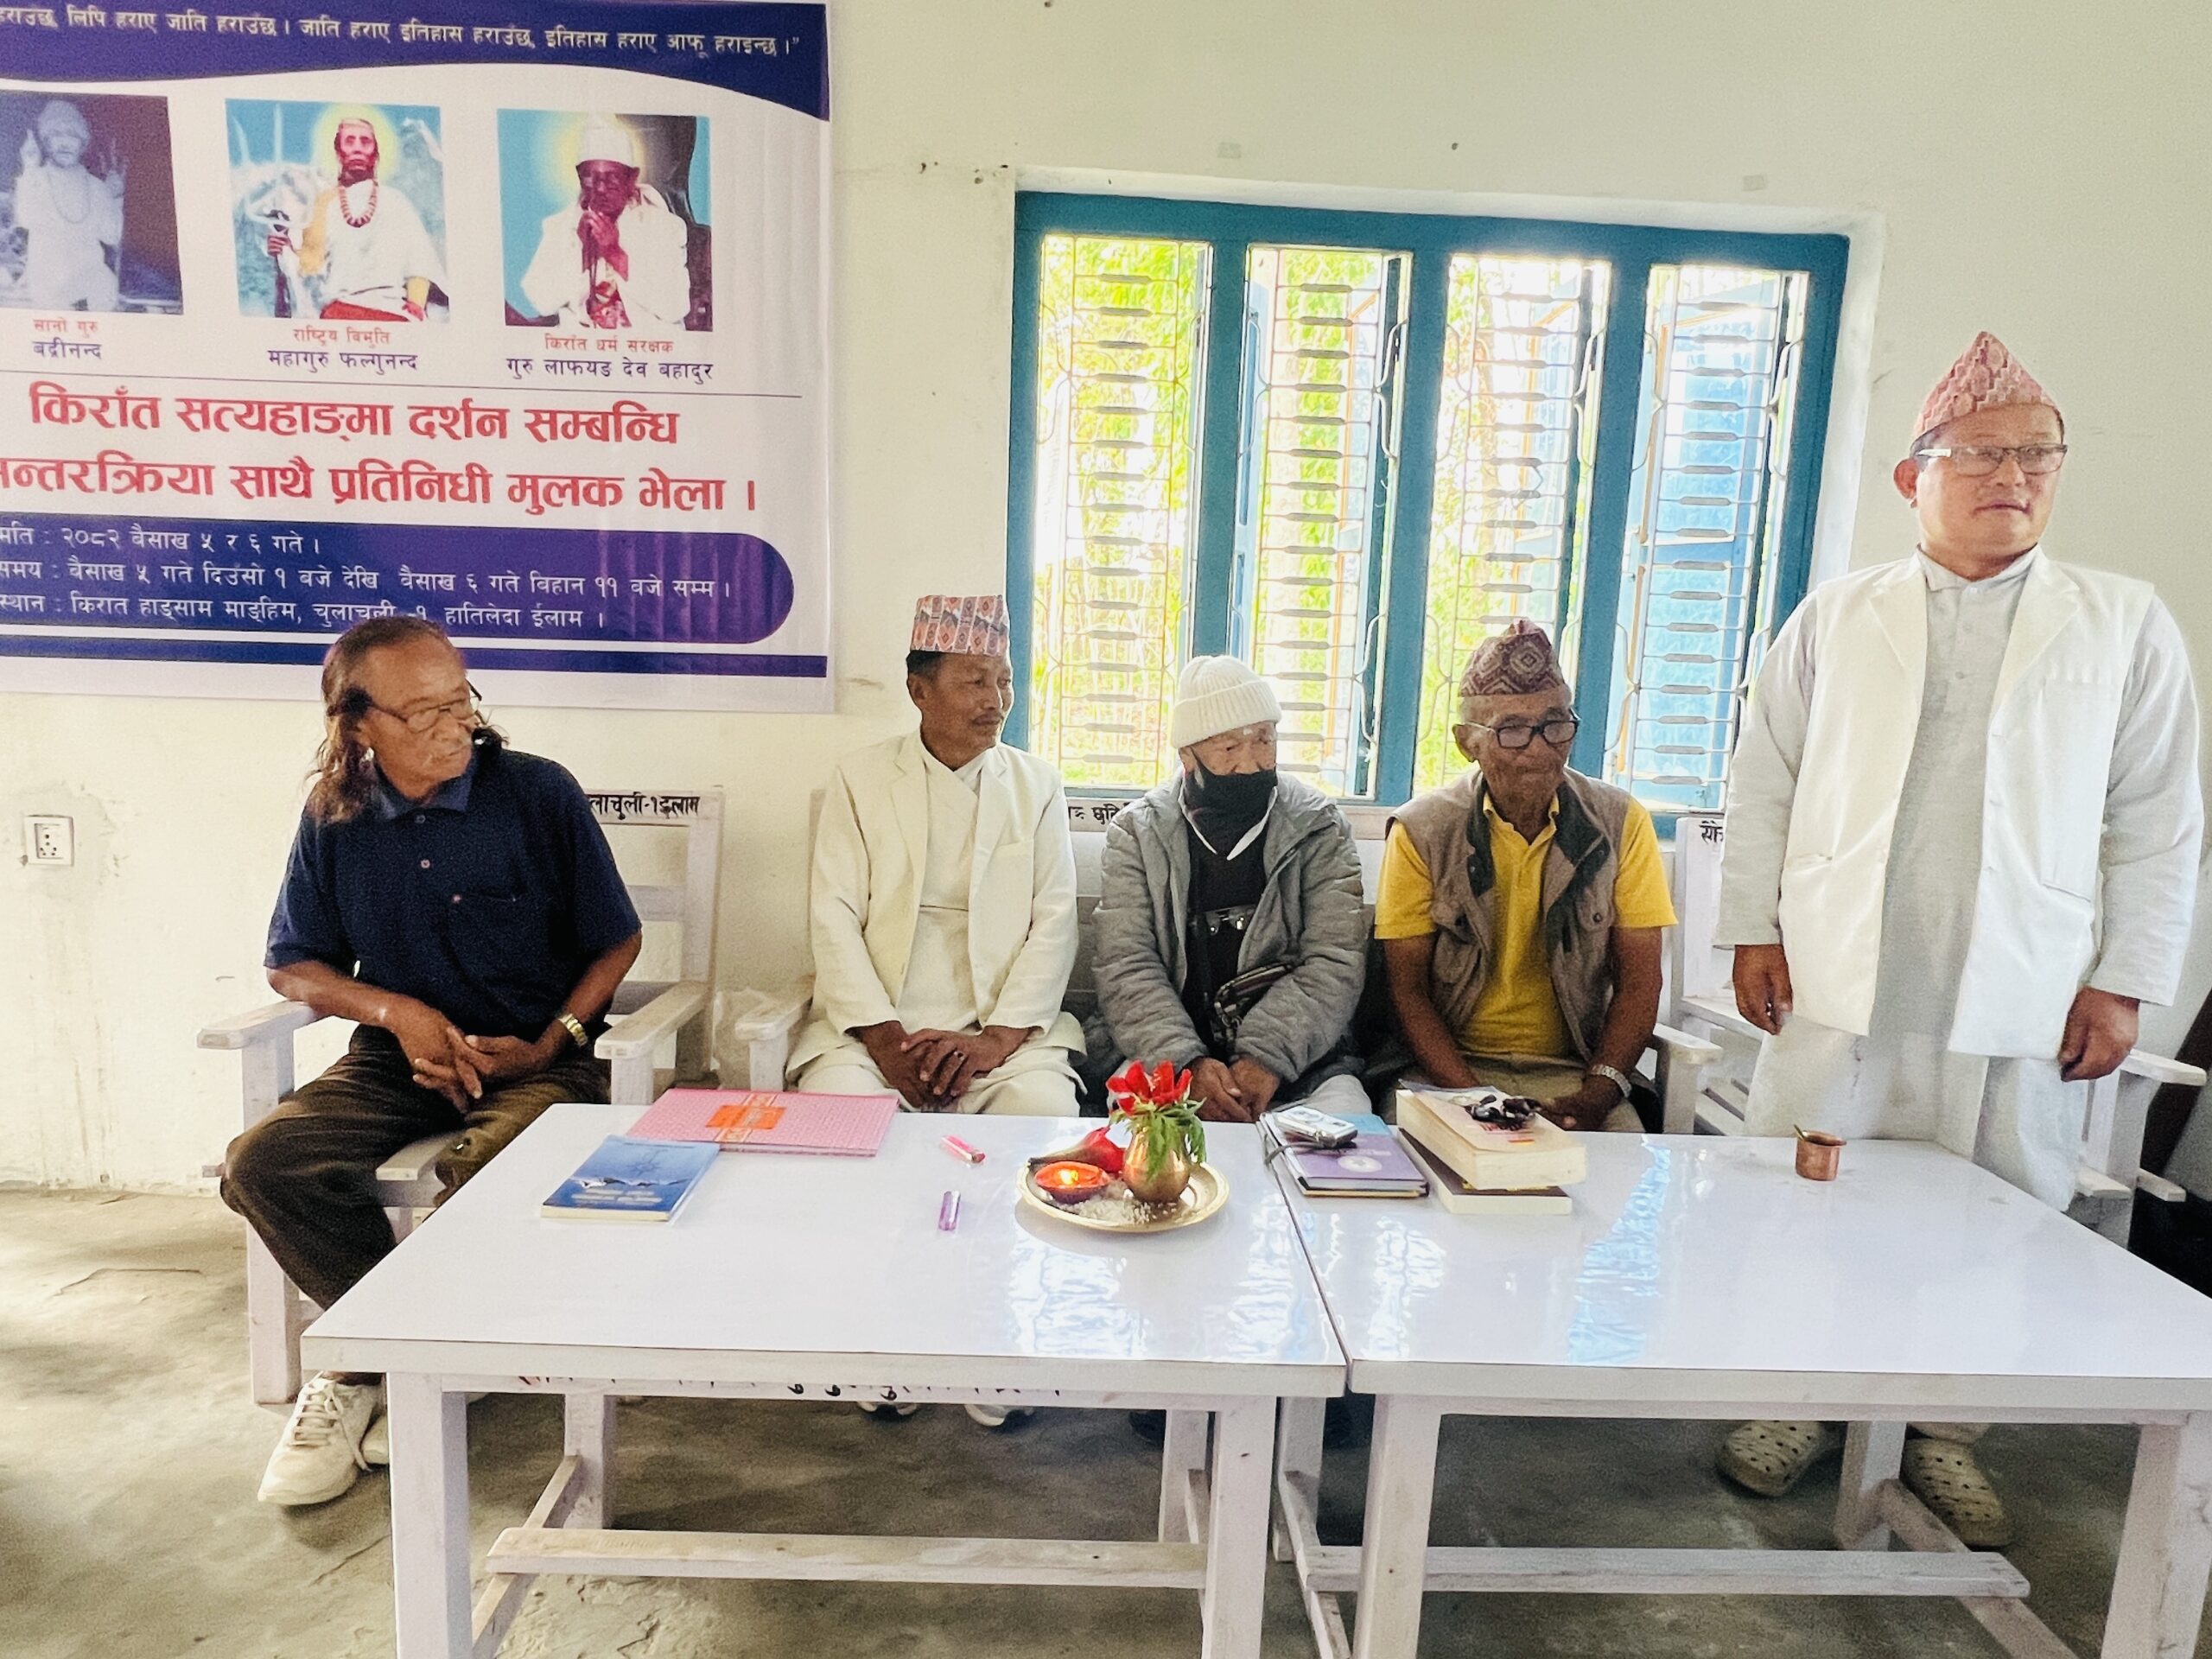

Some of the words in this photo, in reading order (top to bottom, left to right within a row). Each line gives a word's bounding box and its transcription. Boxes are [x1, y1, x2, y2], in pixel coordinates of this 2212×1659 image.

[67, 4, 106, 27] लिपि
[115, 11, 157, 34] हराए
[166, 9, 207, 32] जाति
[299, 15, 341, 37] जाति
[350, 22, 391, 44] हराए
[399, 17, 463, 42] इतिहास
[544, 24, 608, 49] इतिहास
[617, 32, 658, 54] हराए
[667, 33, 709, 59] आफू
[33, 317, 67, 332] सानो
[76, 320, 99, 337] गुरु
[32, 336, 103, 359] बद्रीनन्द
[267, 349, 330, 373] महागुरु
[340, 353, 417, 376] फल्गुनन्द
[506, 358, 533, 380] गुरु
[622, 355, 648, 378] देव
[658, 363, 715, 385] बहादुर
[29, 380, 162, 429] किराँत
[408, 397, 510, 441] दर्शन
[524, 399, 681, 444] सम्बन्धि
[229, 455, 315, 500] साथै
[328, 457, 493, 505] प्रतिनिधी
[506, 473, 625, 517] मुलक
[639, 467, 727, 512] भेला
[61, 528, 120, 550] २०८२
[226, 534, 239, 551] र
[249, 534, 261, 556] ६
[272, 531, 305, 554] गते
[161, 560, 194, 583] गते
[342, 564, 380, 589] देखि
[466, 572, 478, 594] ६
[488, 569, 520, 594] गते
[672, 579, 715, 599] सम्म
[443, 601, 521, 628] हातिलेदा
[530, 601, 584, 629] ईलाम
